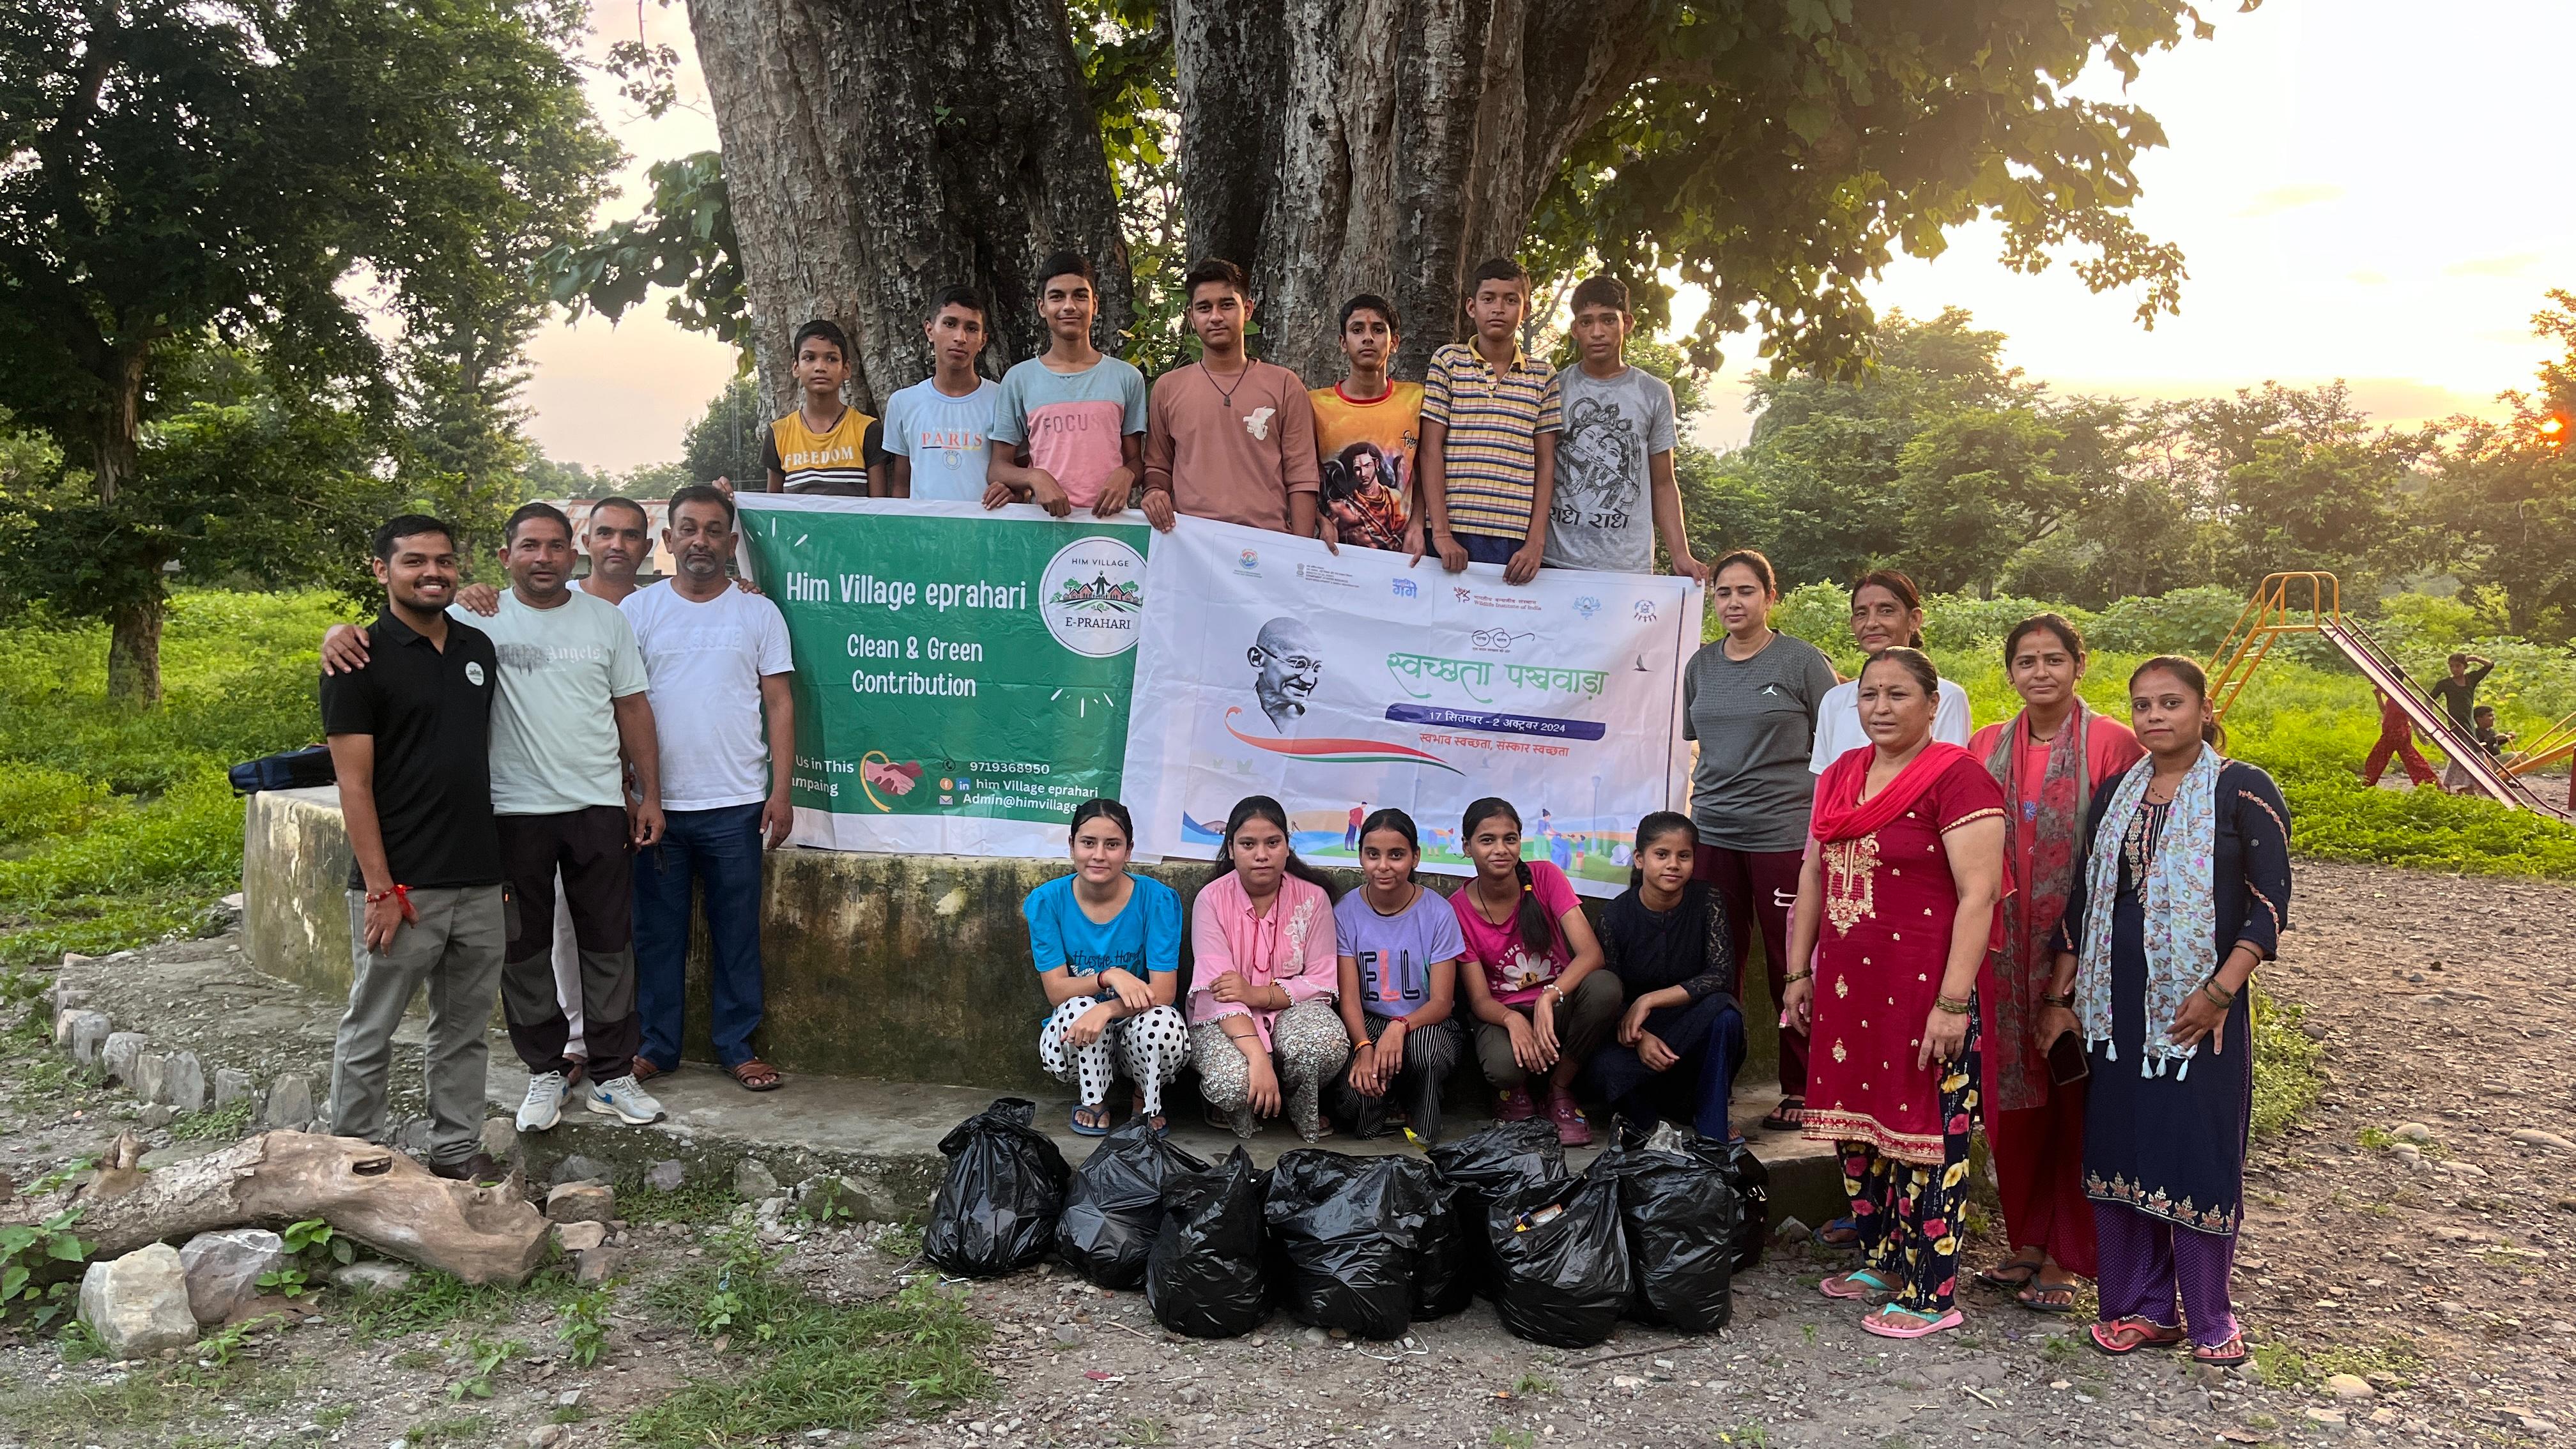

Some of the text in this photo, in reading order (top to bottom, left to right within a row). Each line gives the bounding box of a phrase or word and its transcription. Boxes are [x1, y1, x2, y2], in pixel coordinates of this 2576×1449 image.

[921, 432, 982, 446] PARIS
[785, 445, 854, 468] FREEDOM
[1588, 507, 1630, 529] राधे
[786, 571, 1027, 613] Him Village eprahari
[1066, 617, 1130, 629] E-PRAHARI
[545, 645, 601, 663] Angels
[847, 634, 983, 662] Clean & Green
[852, 670, 976, 697] Contribution
[1386, 652, 1495, 703] स्वच्छता
[1429, 712, 1441, 721] 17
[1492, 718, 1499, 726] 2
[1540, 723, 1566, 733] 2024
[1419, 733, 1569, 756] स्वभाव स्वच्छता, संस्कार स्वच्छता
[795, 755, 854, 773] Us in This
[970, 762, 1050, 774] 9719368950
[792, 777, 839, 797] mpaing
[976, 779, 1000, 790] him
[1003, 780, 1045, 795] Village
[1048, 785, 1098, 798] eprahari
[963, 793, 1078, 814] Admin@himvillage
[1073, 950, 1113, 968] Hustle
[1504, 944, 1520, 959] THE
[1359, 948, 1429, 1002] ELL
